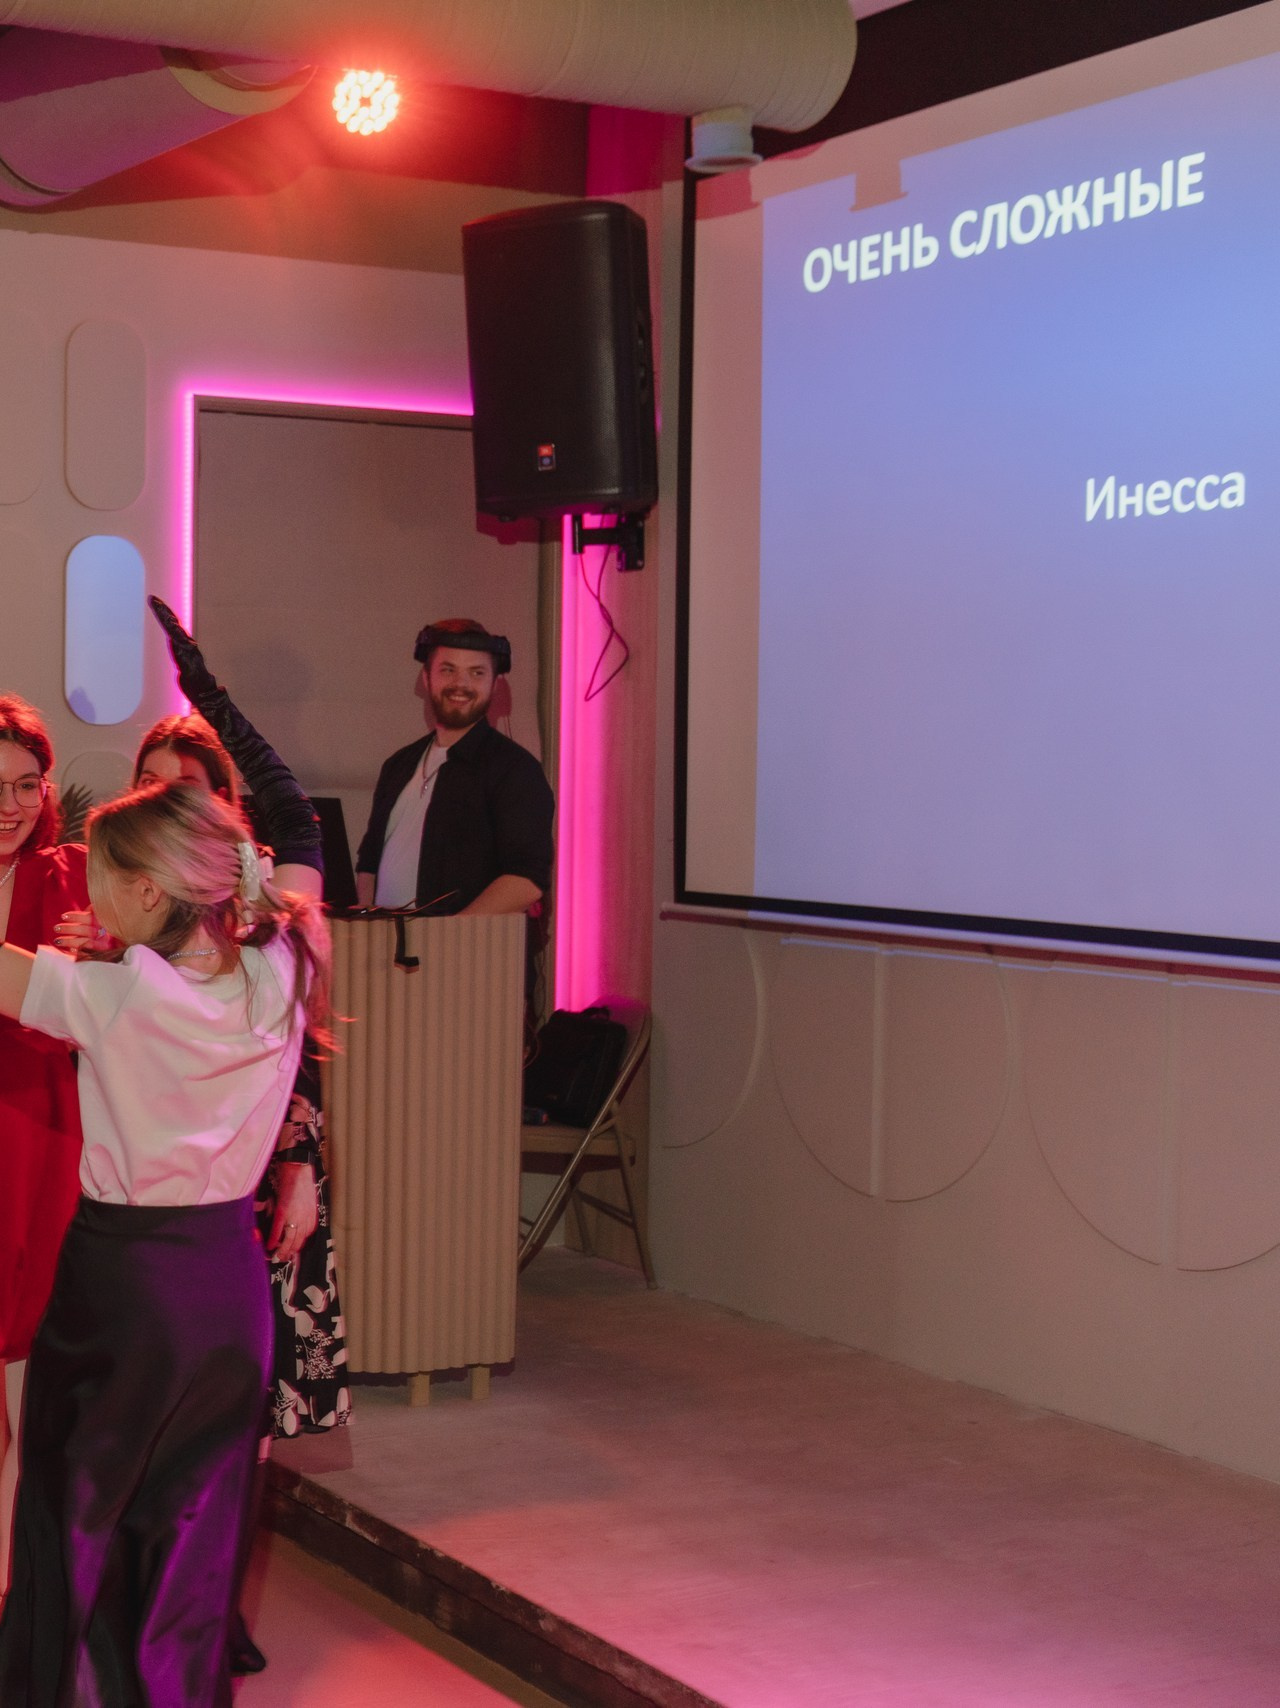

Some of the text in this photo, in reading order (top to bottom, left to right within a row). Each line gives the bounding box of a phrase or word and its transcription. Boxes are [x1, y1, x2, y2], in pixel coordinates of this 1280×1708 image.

[803, 151, 1206, 293] ОЧЕНЬ СЛОЖНЫЕ
[1085, 471, 1246, 522] Инесса
